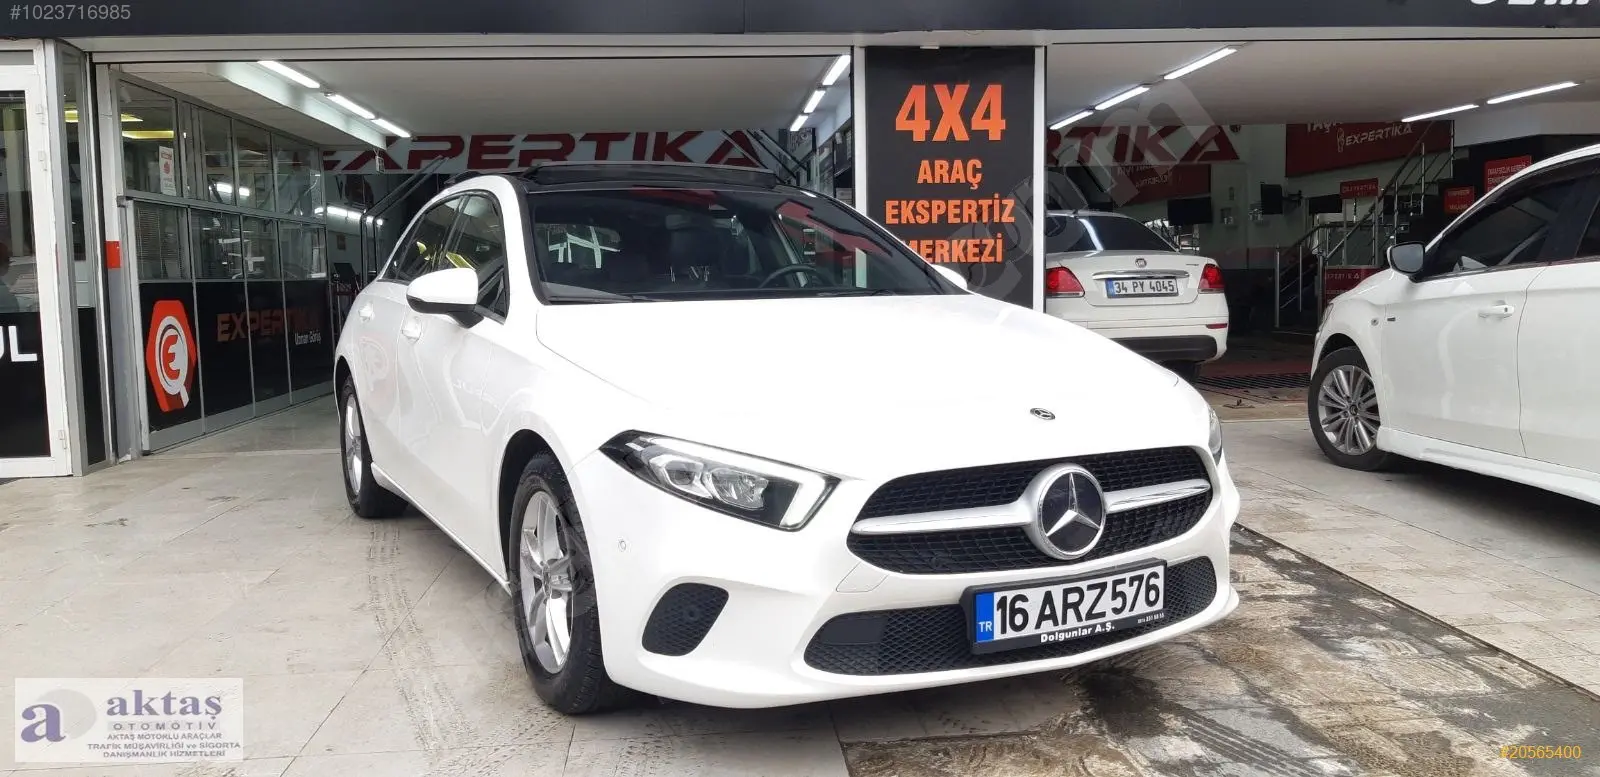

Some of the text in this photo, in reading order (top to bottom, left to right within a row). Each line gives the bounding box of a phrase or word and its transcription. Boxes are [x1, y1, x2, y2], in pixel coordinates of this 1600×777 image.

[895, 83, 1007, 142] 4X4
[917, 159, 983, 190] ARAÇ
[885, 193, 1015, 225] EKSPERTİZ
[1115, 280, 1175, 293] 34 PY 4045
[996, 571, 1160, 634] 16 ARZ 576
[979, 621, 993, 633] TR
[1040, 621, 1115, 643] Dolgunlar A.Ş.
